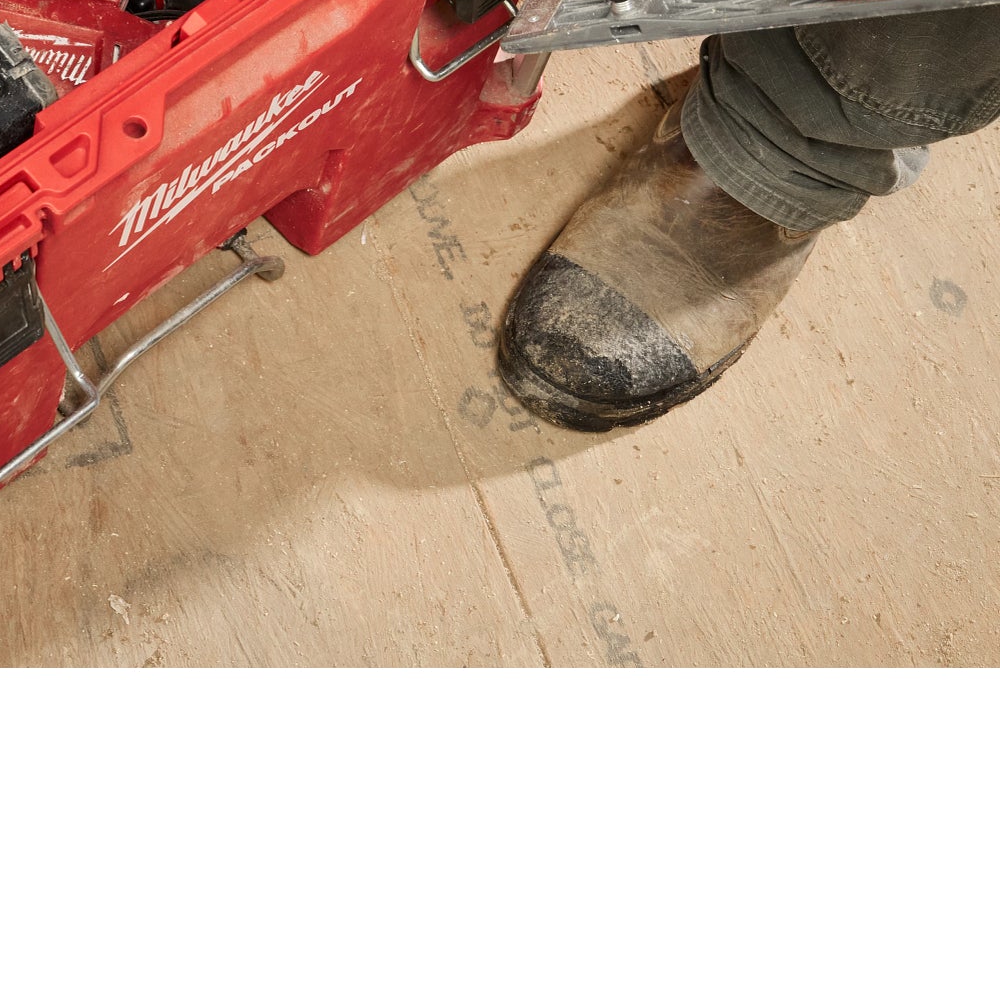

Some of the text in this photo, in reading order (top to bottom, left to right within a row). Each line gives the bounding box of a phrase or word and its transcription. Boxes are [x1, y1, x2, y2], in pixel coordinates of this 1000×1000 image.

[108, 70, 324, 247] Milwaukee
[211, 77, 363, 195] PACKOUT
[525, 457, 597, 578] CLOSE
